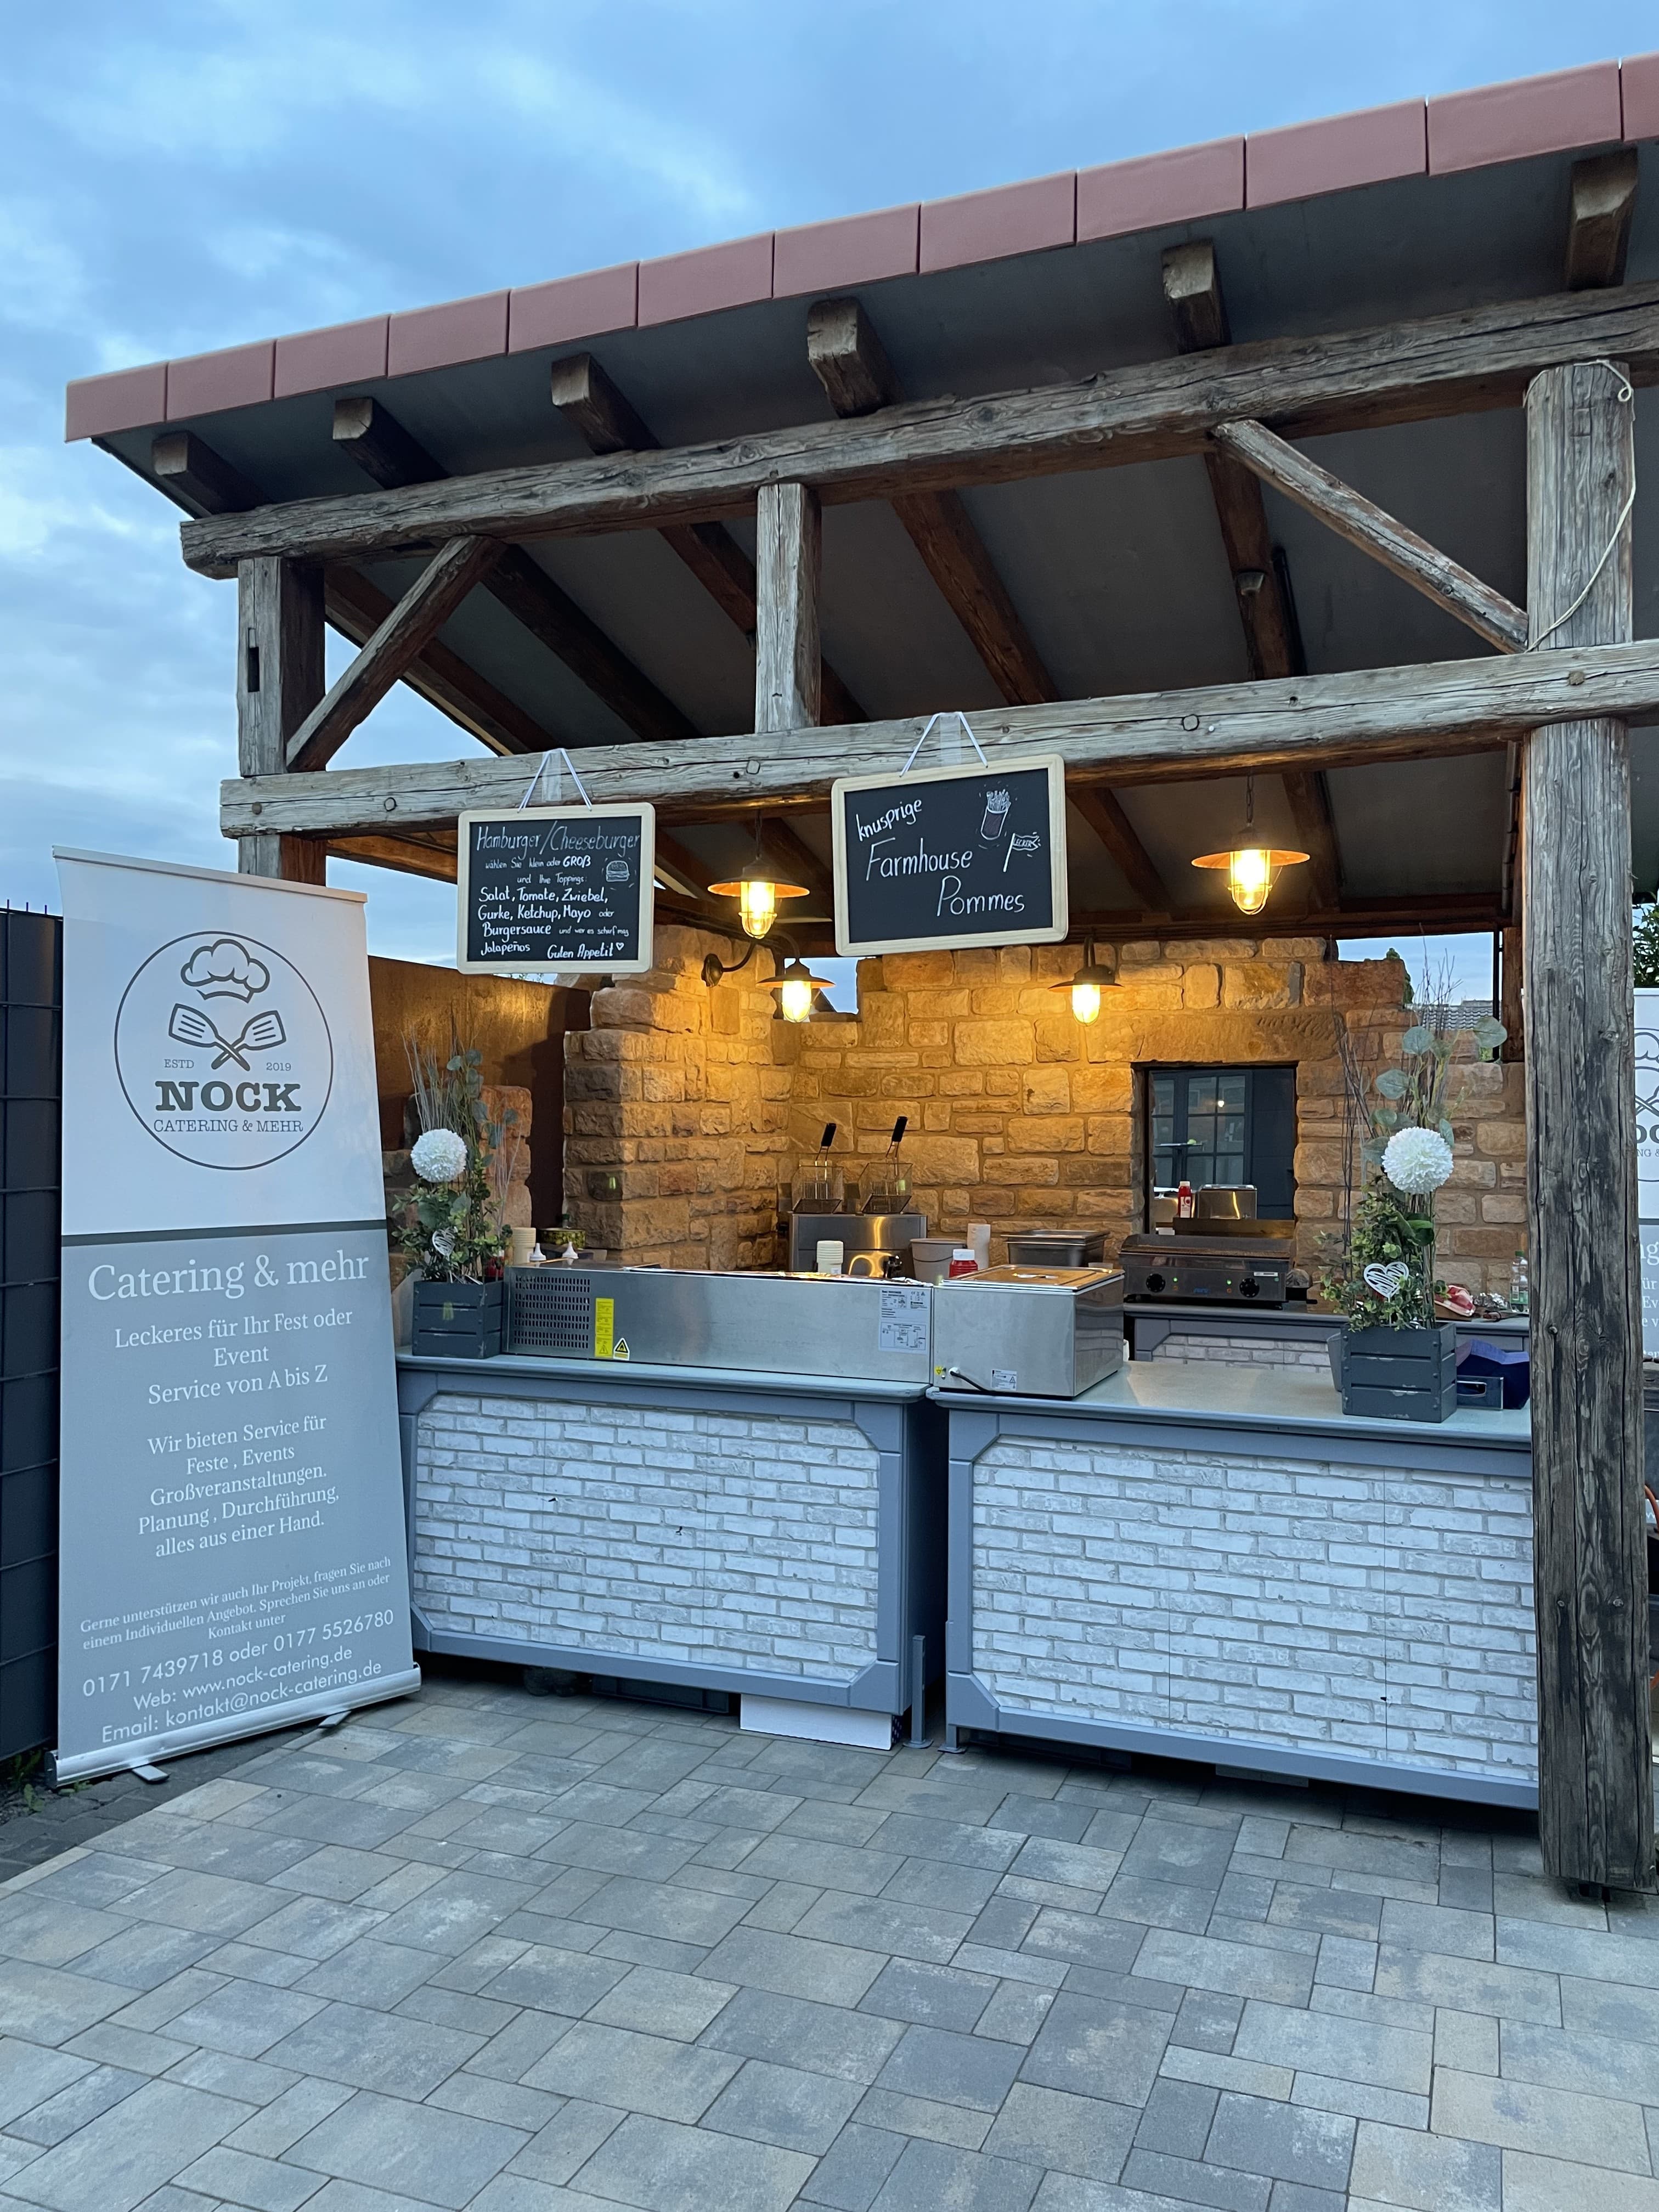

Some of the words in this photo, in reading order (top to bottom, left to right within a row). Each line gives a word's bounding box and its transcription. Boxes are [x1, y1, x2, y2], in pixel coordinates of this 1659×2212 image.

[856, 799, 922, 842] knusprige
[866, 837, 973, 881] Farmhouse
[1013, 838, 1032, 848] LECKER
[511, 857, 522, 868] Sie
[529, 857, 544, 868] klein
[546, 857, 561, 867] oder
[517, 874, 531, 884] und
[539, 874, 551, 884] Ihre
[517, 887, 559, 902] Tomate,
[561, 887, 608, 904] Zwiebel,
[936, 875, 1025, 917] Pommes
[478, 905, 513, 921] Gurke,
[517, 904, 561, 922] Ketchup,
[563, 905, 591, 923] Mayo
[599, 907, 614, 917] oder
[481, 941, 531, 956] Jalapeños
[483, 922, 551, 943] Burgersauce
[559, 926, 572, 934] und
[548, 944, 574, 959] Guten
[577, 942, 614, 960] Appetit
[164, 1059, 194, 1069] ESTD
[266, 1062, 291, 1072] 2019
[155, 1081, 301, 1112] NOCK
[154, 1120, 238, 1132] CATERING
[242, 1120, 253, 1132] &
[256, 1120, 304, 1133] MEHR
[88, 1259, 245, 1300] Catering
[254, 1255, 279, 1286] &
[287, 1250, 369, 1285] mehr
[115, 1324, 202, 1348] Leckeres
[208, 1319, 238, 1338] für
[243, 1316, 270, 1335] Ihr
[274, 1313, 308, 1332] Fest
[313, 1308, 353, 1327] oder
[214, 1346, 269, 1367] Event
[148, 1380, 221, 1404] Service
[226, 1379, 263, 1394] von
[267, 1370, 281, 1389] A
[285, 1368, 310, 1386] bis
[315, 1364, 328, 1383] Z
[147, 1436, 182, 1454] Wir
[186, 1430, 238, 1450] bieten
[243, 1420, 299, 1441] Service
[303, 1415, 326, 1432] für
[242, 1447, 295, 1466] Events
[150, 1465, 327, 1505] Großveranstaltungen.
[222, 1486, 339, 1519] Durchführung,
[156, 1538, 194, 1557] alles
[199, 1532, 227, 1549] aus
[232, 1524, 275, 1542] einer
[279, 1510, 324, 1534] Hand.
[81, 1617, 119, 1632] Gerne
[123, 1600, 197, 1624] unterstützen
[200, 1593, 219, 1606] wir
[222, 1587, 249, 1602] auch
[252, 1583, 269, 1595] Ihr
[314, 1571, 347, 1582] fragen
[350, 1562, 365, 1575] Sie
[368, 1556, 391, 1571] nach
[83, 1634, 122, 1650] einem
[126, 1616, 204, 1641] Individuellen
[206, 1604, 256, 1623] Angebot.
[259, 1593, 311, 1612] Sprechen
[313, 1587, 329, 1599] Sie
[331, 1583, 351, 1595] uns
[352, 1581, 365, 1590] an
[368, 1574, 390, 1586] oder
[208, 1620, 252, 1639] Kontakt
[256, 1615, 286, 1628] unter
[83, 1671, 129, 1696] 0171
[141, 1649, 223, 1684] 7439718
[229, 1641, 268, 1662] oder
[274, 1628, 316, 1651] 0177
[323, 1609, 394, 1640] 5526780
[133, 1689, 176, 1711] Web:
[183, 1646, 352, 1699] www.nock-catering.de
[102, 1714, 158, 1743] Email:
[166, 1660, 381, 1726] kontakt@nock-catering.de
